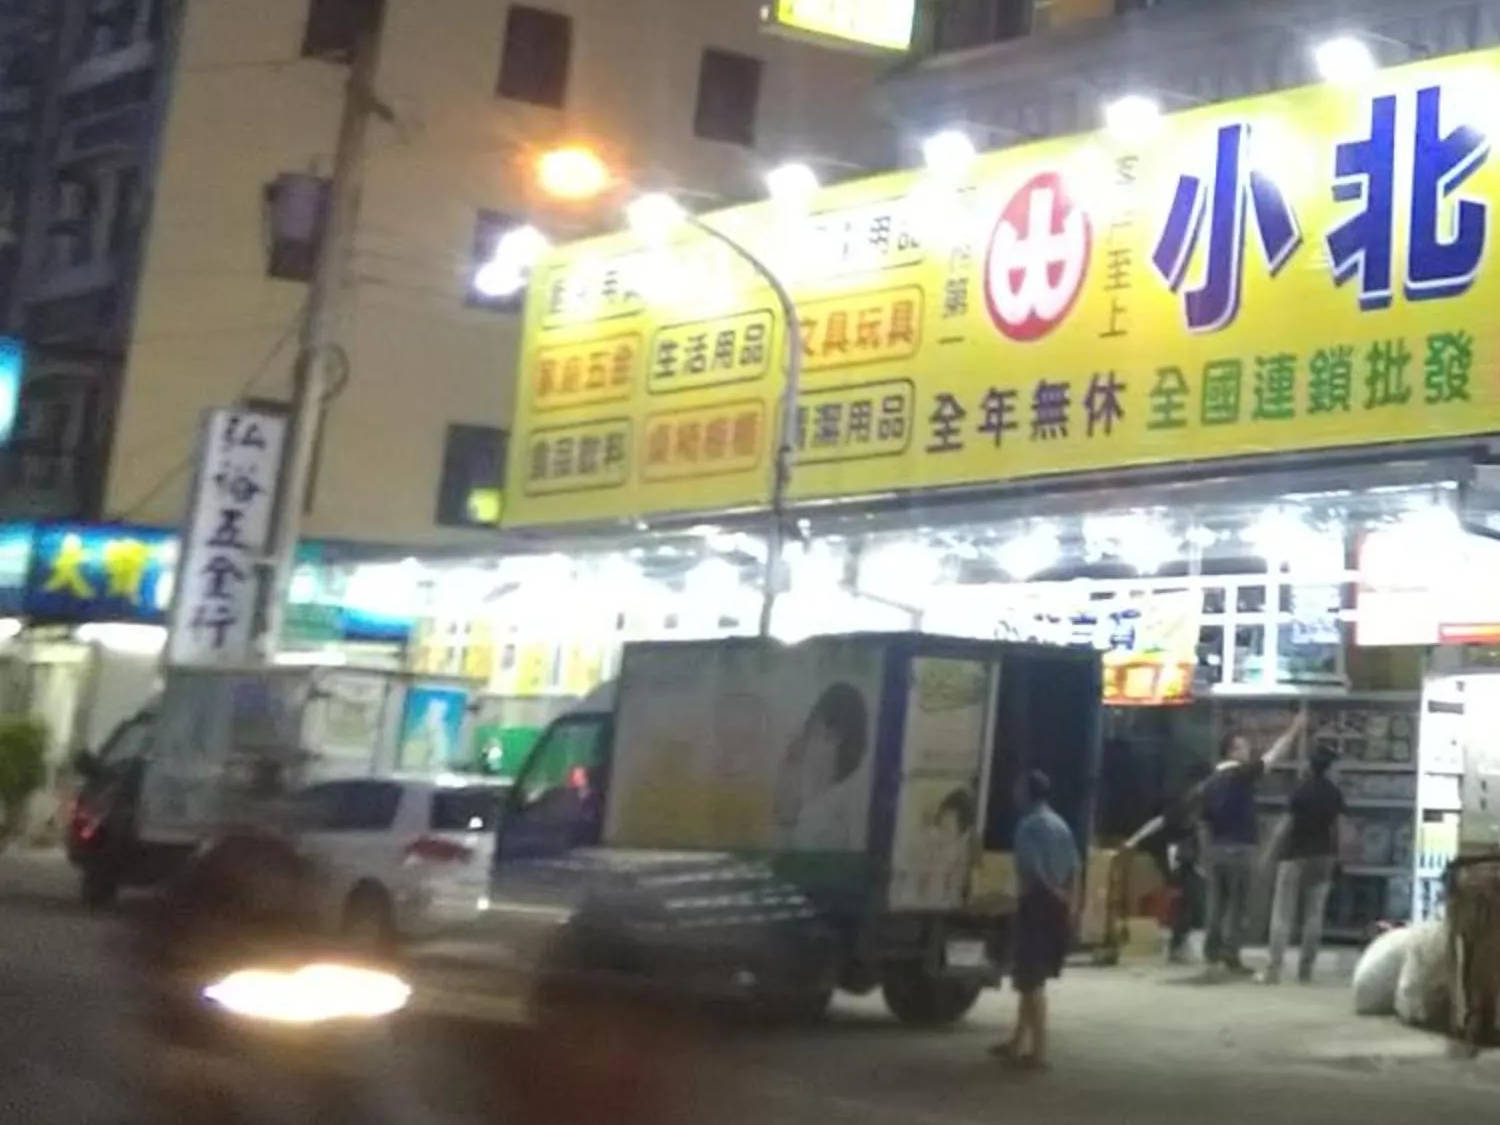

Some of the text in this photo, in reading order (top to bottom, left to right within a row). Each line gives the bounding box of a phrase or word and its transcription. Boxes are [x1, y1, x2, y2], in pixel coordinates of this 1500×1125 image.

[653, 323, 767, 378] 生活用品
[924, 372, 1128, 455] 全年無休
[1146, 329, 1475, 432] 全國連鎖批發
